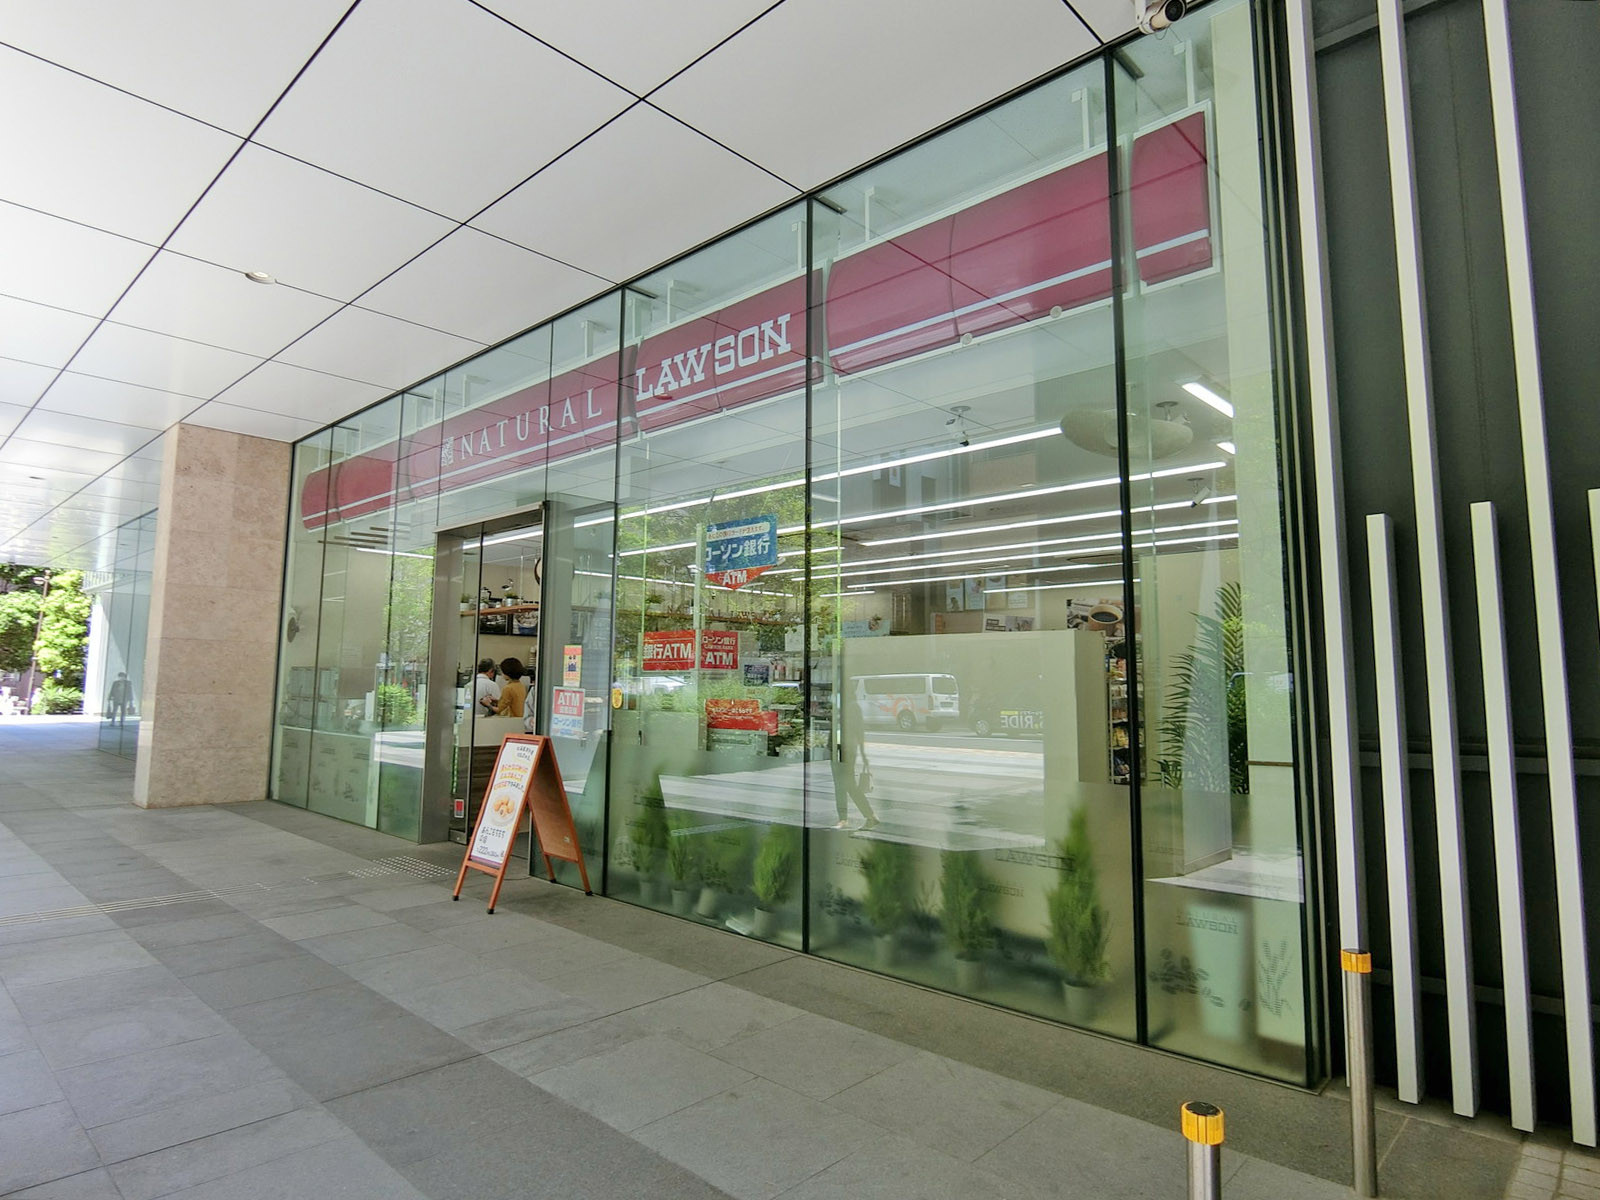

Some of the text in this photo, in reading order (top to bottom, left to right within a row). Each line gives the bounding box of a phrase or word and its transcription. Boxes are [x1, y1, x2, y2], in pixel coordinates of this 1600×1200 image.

[460, 313, 792, 460] NATURAL LAWSON
[705, 534, 771, 562] ローソン銀行
[722, 570, 748, 585] ATM
[702, 636, 736, 646] ローソン銀行
[643, 642, 692, 660] 銀行ATM
[704, 652, 734, 666] ATM
[557, 692, 580, 706] ATM
[1175, 915, 1239, 935] LAWSON
